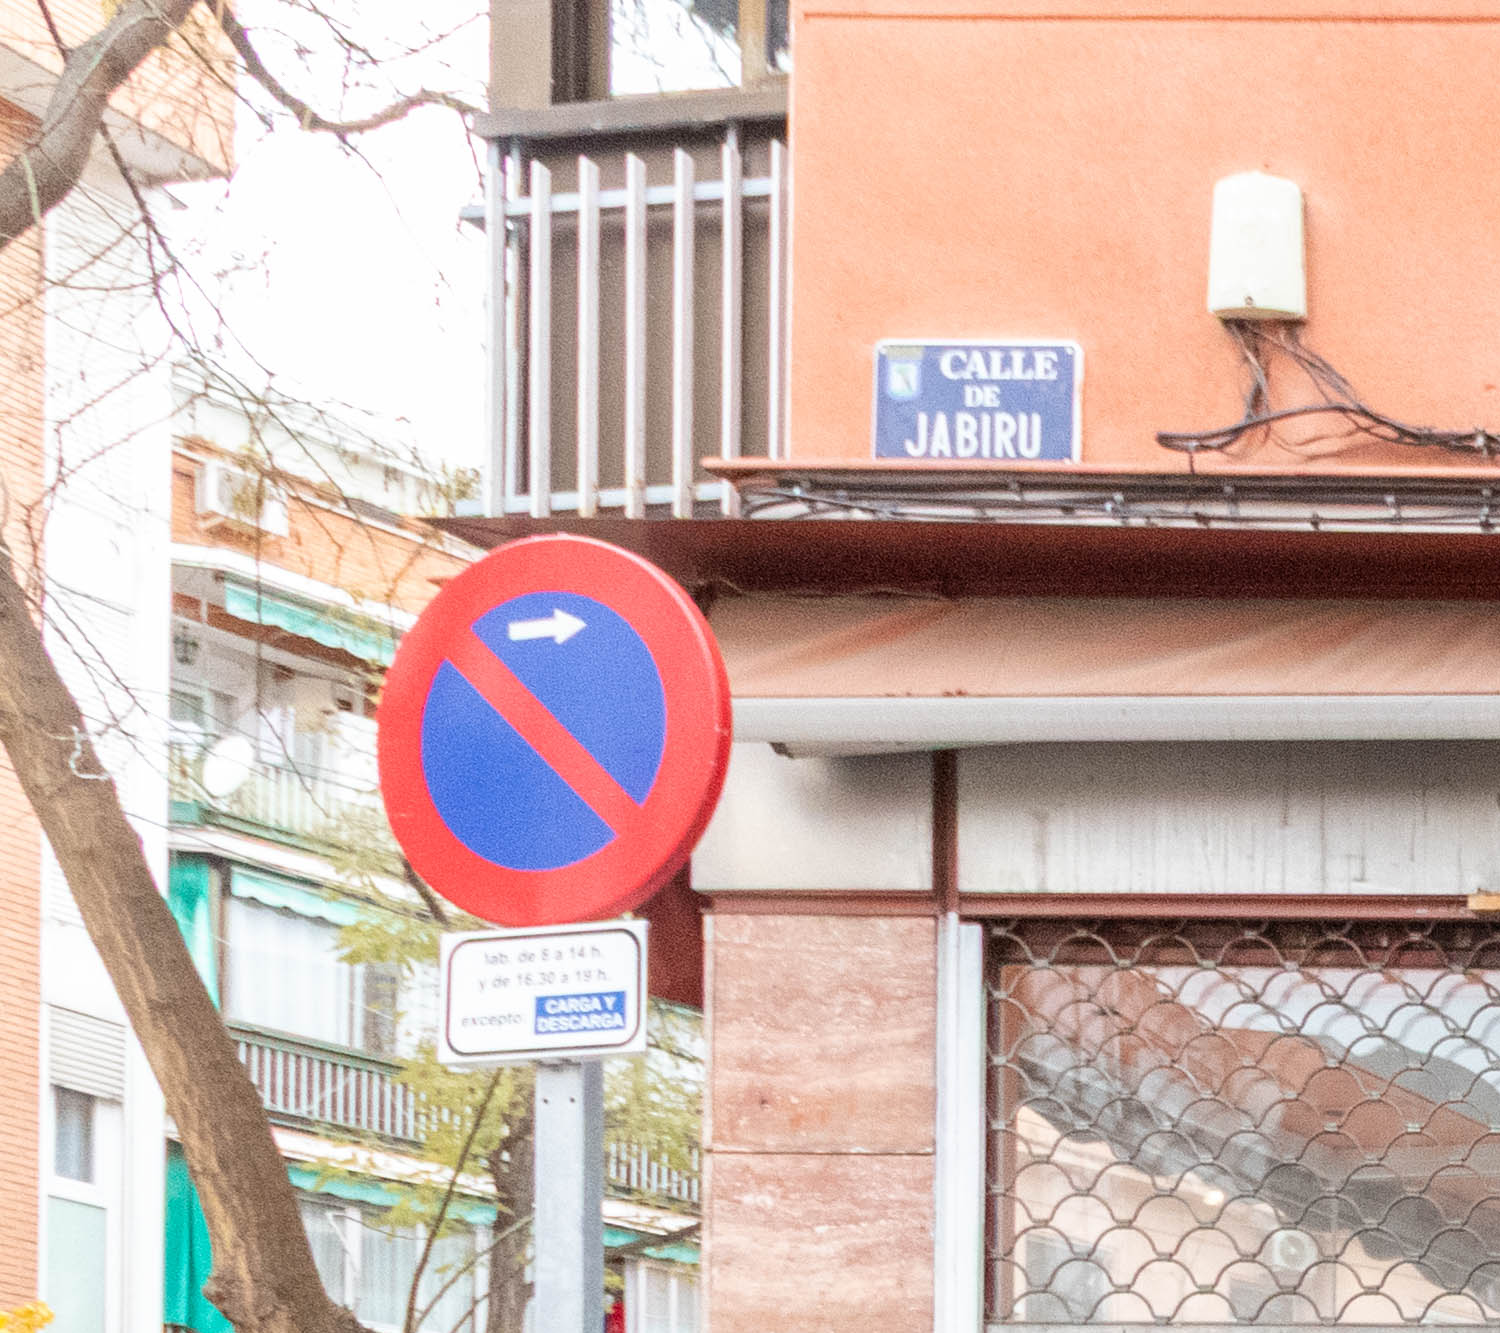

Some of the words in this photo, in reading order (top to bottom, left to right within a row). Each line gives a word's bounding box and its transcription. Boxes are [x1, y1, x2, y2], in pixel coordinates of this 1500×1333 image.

[940, 350, 1058, 380] CALLE
[963, 385, 1001, 407] DE
[904, 411, 1043, 458] JABIRU
[517, 948, 535, 963] de
[570, 945, 586, 960] 14
[492, 973, 511, 989] de
[544, 997, 602, 1015] CARGA
[603, 996, 617, 1011] Y
[536, 1012, 624, 1032] DESCARGA
